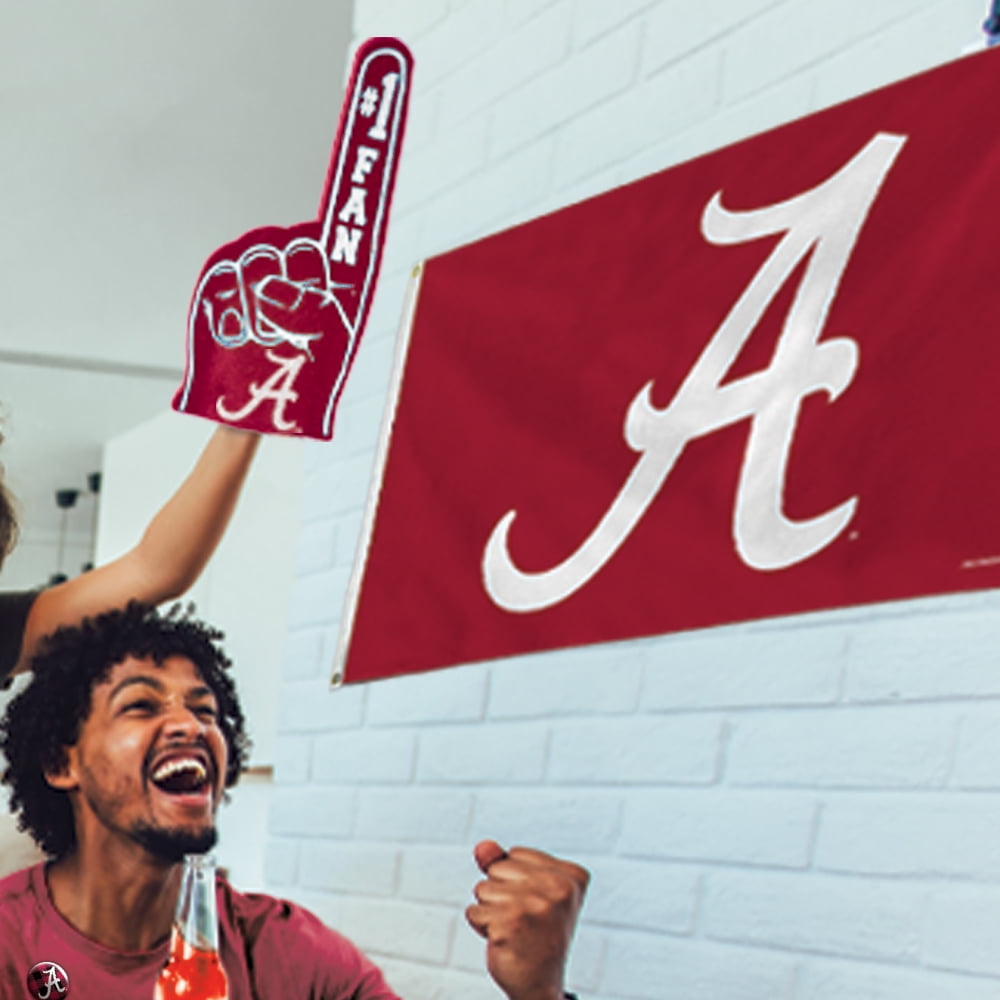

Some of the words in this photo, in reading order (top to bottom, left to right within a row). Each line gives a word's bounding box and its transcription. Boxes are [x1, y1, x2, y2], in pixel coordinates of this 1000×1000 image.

[359, 72, 401, 141] #1
[330, 145, 379, 266] FAN
[215, 348, 306, 432] A
[482, 131, 909, 614] A
[37, 965, 66, 1000] A
